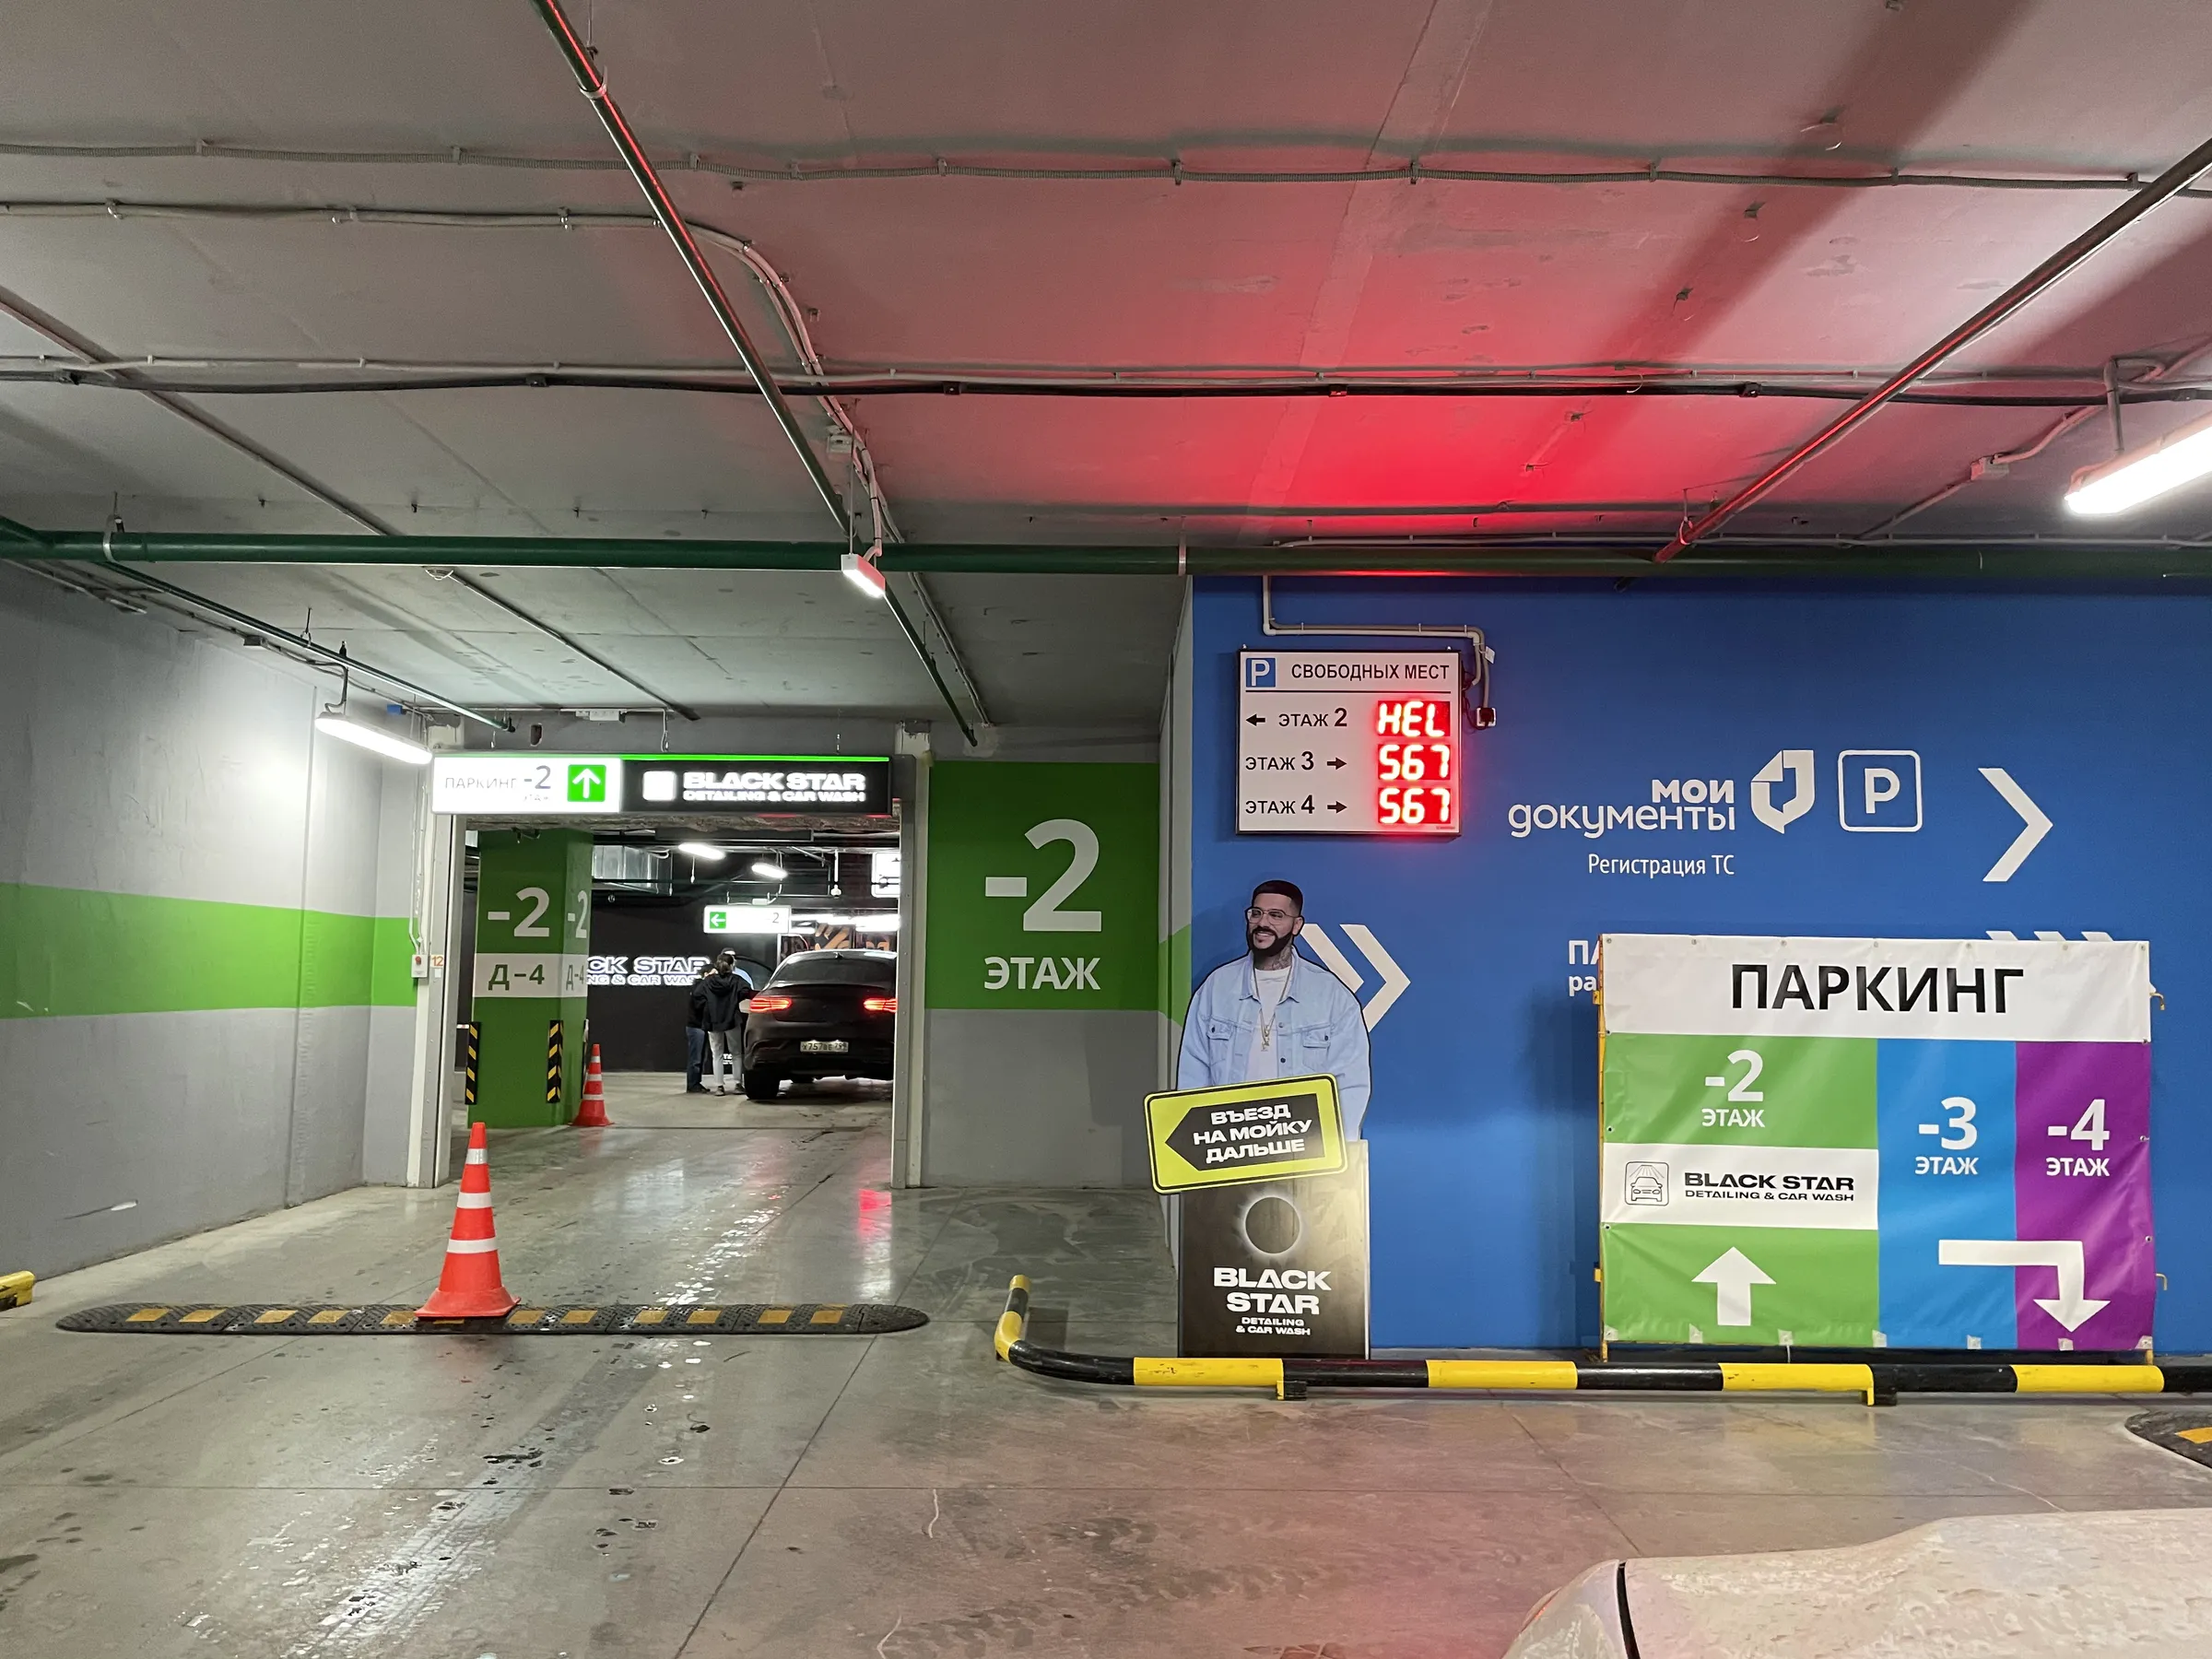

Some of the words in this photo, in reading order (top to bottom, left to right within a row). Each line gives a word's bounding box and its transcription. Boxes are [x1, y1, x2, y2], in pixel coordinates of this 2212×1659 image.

[1291, 664, 1400, 681] СВОБОДНЫХ
[1405, 665, 1450, 680] МЕСТ
[1278, 713, 1328, 727] ЭТАЖ
[1334, 707, 1347, 727] 2
[1378, 700, 1445, 737] HEL
[1245, 757, 1296, 771] ЭТАЖ
[1300, 751, 1314, 771] 3
[445, 777, 517, 789] ПАРКИНГ
[524, 765, 551, 790] -2
[683, 771, 784, 790] BLACK
[786, 772, 866, 791] STAR
[683, 791, 766, 801] DETAILING
[782, 791, 817, 801] CAR
[818, 791, 866, 802] WASH
[1245, 800, 1296, 815] ЭТАЖ
[1300, 794, 1315, 815] 4
[1508, 805, 1735, 839] документы
[984, 818, 1102, 932] -2
[1588, 853, 1706, 878] Регистрация
[1712, 854, 1735, 875] ТС
[488, 887, 550, 937] -2
[567, 889, 588, 938] -2
[431, 956, 444, 967] 12
[627, 974, 662, 985] CAR
[984, 957, 1101, 990] ЭТАЖ
[1732, 964, 2024, 1013] ПАРКИНГ
[1705, 1050, 1764, 1101] -2
[1210, 1104, 1291, 1125] ВЪЕЗД
[1701, 1109, 1765, 1128] ЭТАЖ
[1918, 1097, 1977, 1150] -3
[2047, 1099, 2110, 1151] -4
[1193, 1130, 1227, 1146] НА
[1230, 1119, 1312, 1142] МОЙКУ
[1206, 1138, 1305, 1164] ДАЛЬШЕ
[1915, 1157, 1979, 1176] ЭТАЖ
[2045, 1157, 2110, 1177] ЭТАЖ
[1685, 1172, 1778, 1189] BLACK
[1783, 1175, 1854, 1191] STAR
[1685, 1190, 1760, 1199] DETAILING
[1764, 1192, 1775, 1200] &
[1812, 1193, 1854, 1201] WASH
[1213, 1266, 1332, 1290] BLACK
[1226, 1292, 1320, 1315] STAR
[1235, 1324, 1245, 1334] &
[1247, 1325, 1273, 1335] CAR
[1275, 1326, 1311, 1335] WASH
[1241, 1316, 1304, 1326] DETAILING
